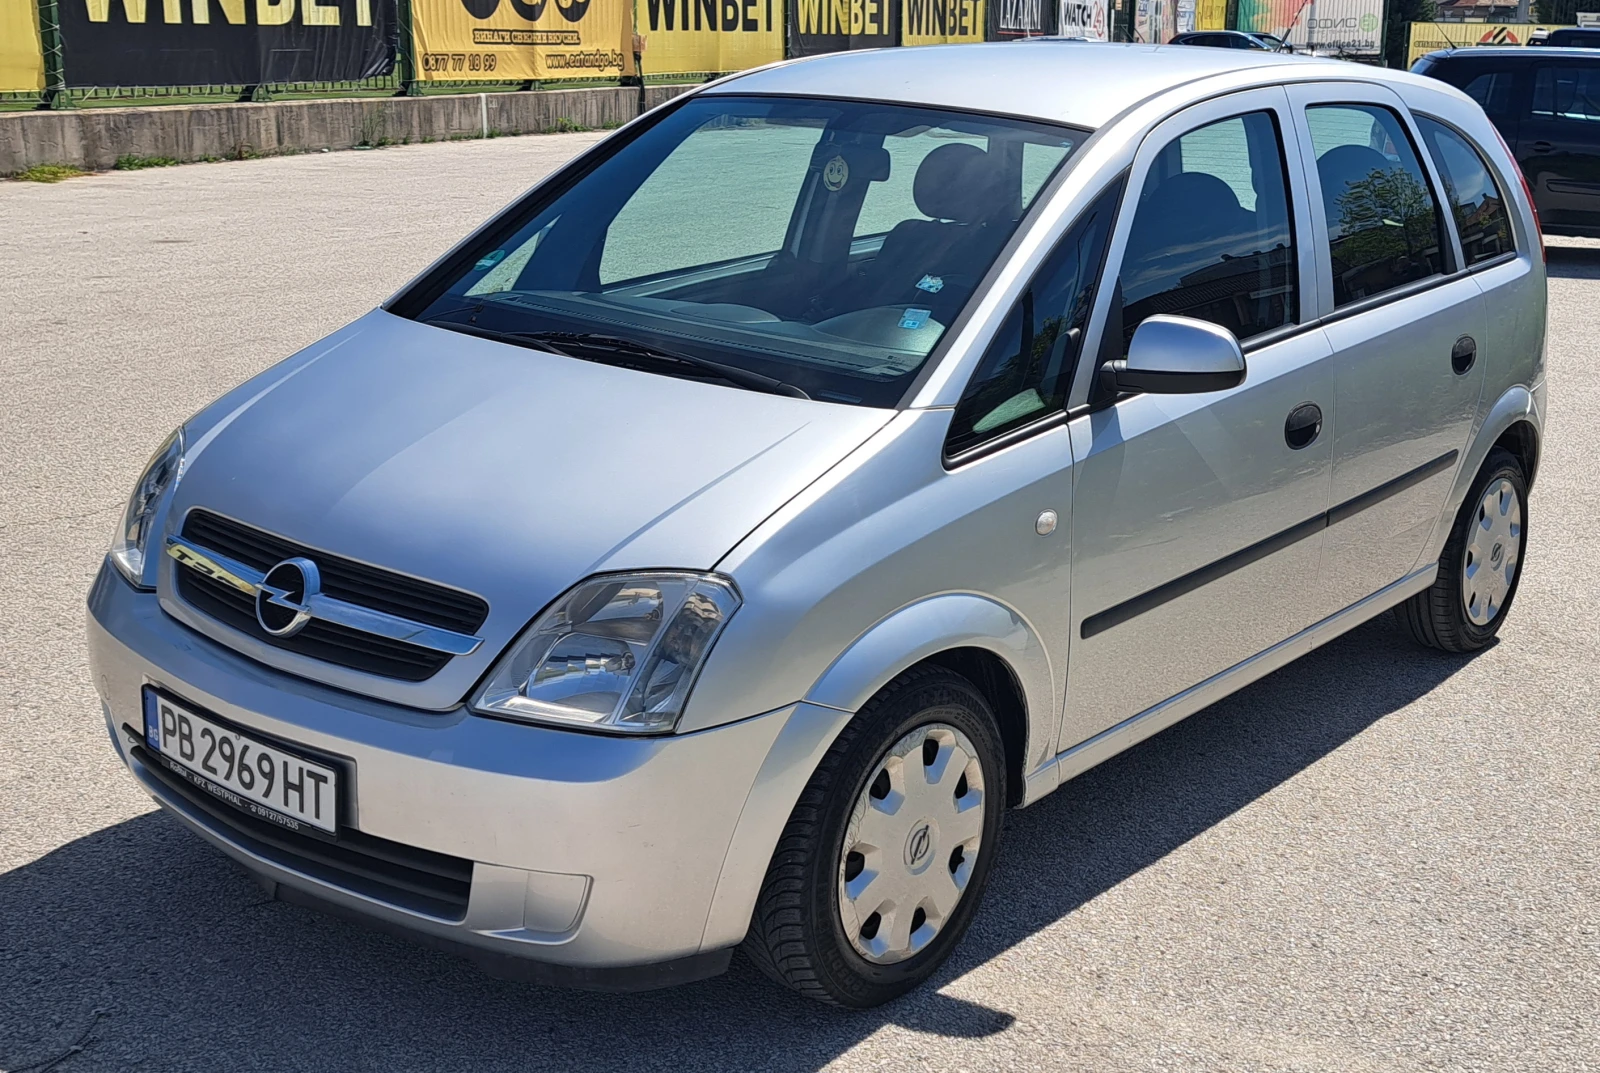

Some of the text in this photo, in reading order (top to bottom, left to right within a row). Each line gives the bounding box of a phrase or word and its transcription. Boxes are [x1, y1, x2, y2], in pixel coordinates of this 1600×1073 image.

[907, 0, 981, 36] WINBET
[1064, 3, 1092, 28] WATCH
[1307, 18, 1357, 29] ОФИС
[423, 53, 497, 72] 0877 77 18 99
[545, 49, 624, 71] www.eatandgo.bg
[149, 725, 159, 741] BG
[161, 704, 328, 820] PB 2969 HT
[207, 782, 243, 807] WESTPHAL
